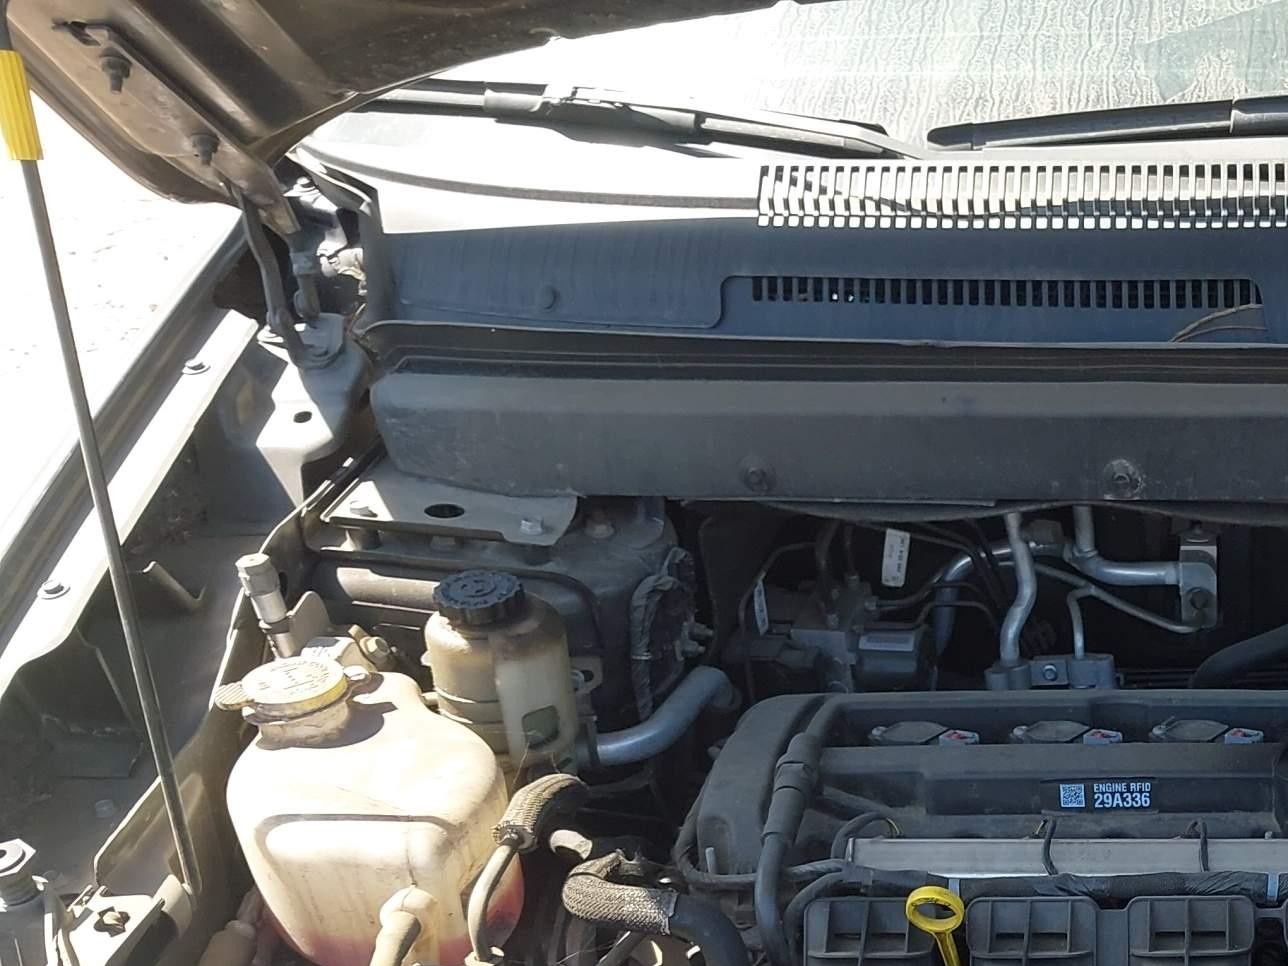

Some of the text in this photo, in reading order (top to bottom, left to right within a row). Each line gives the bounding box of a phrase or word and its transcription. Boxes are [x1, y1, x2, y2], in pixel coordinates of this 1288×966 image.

[1093, 782, 1151, 792] ENGINE RFID
[1094, 792, 1151, 808] 29A336
